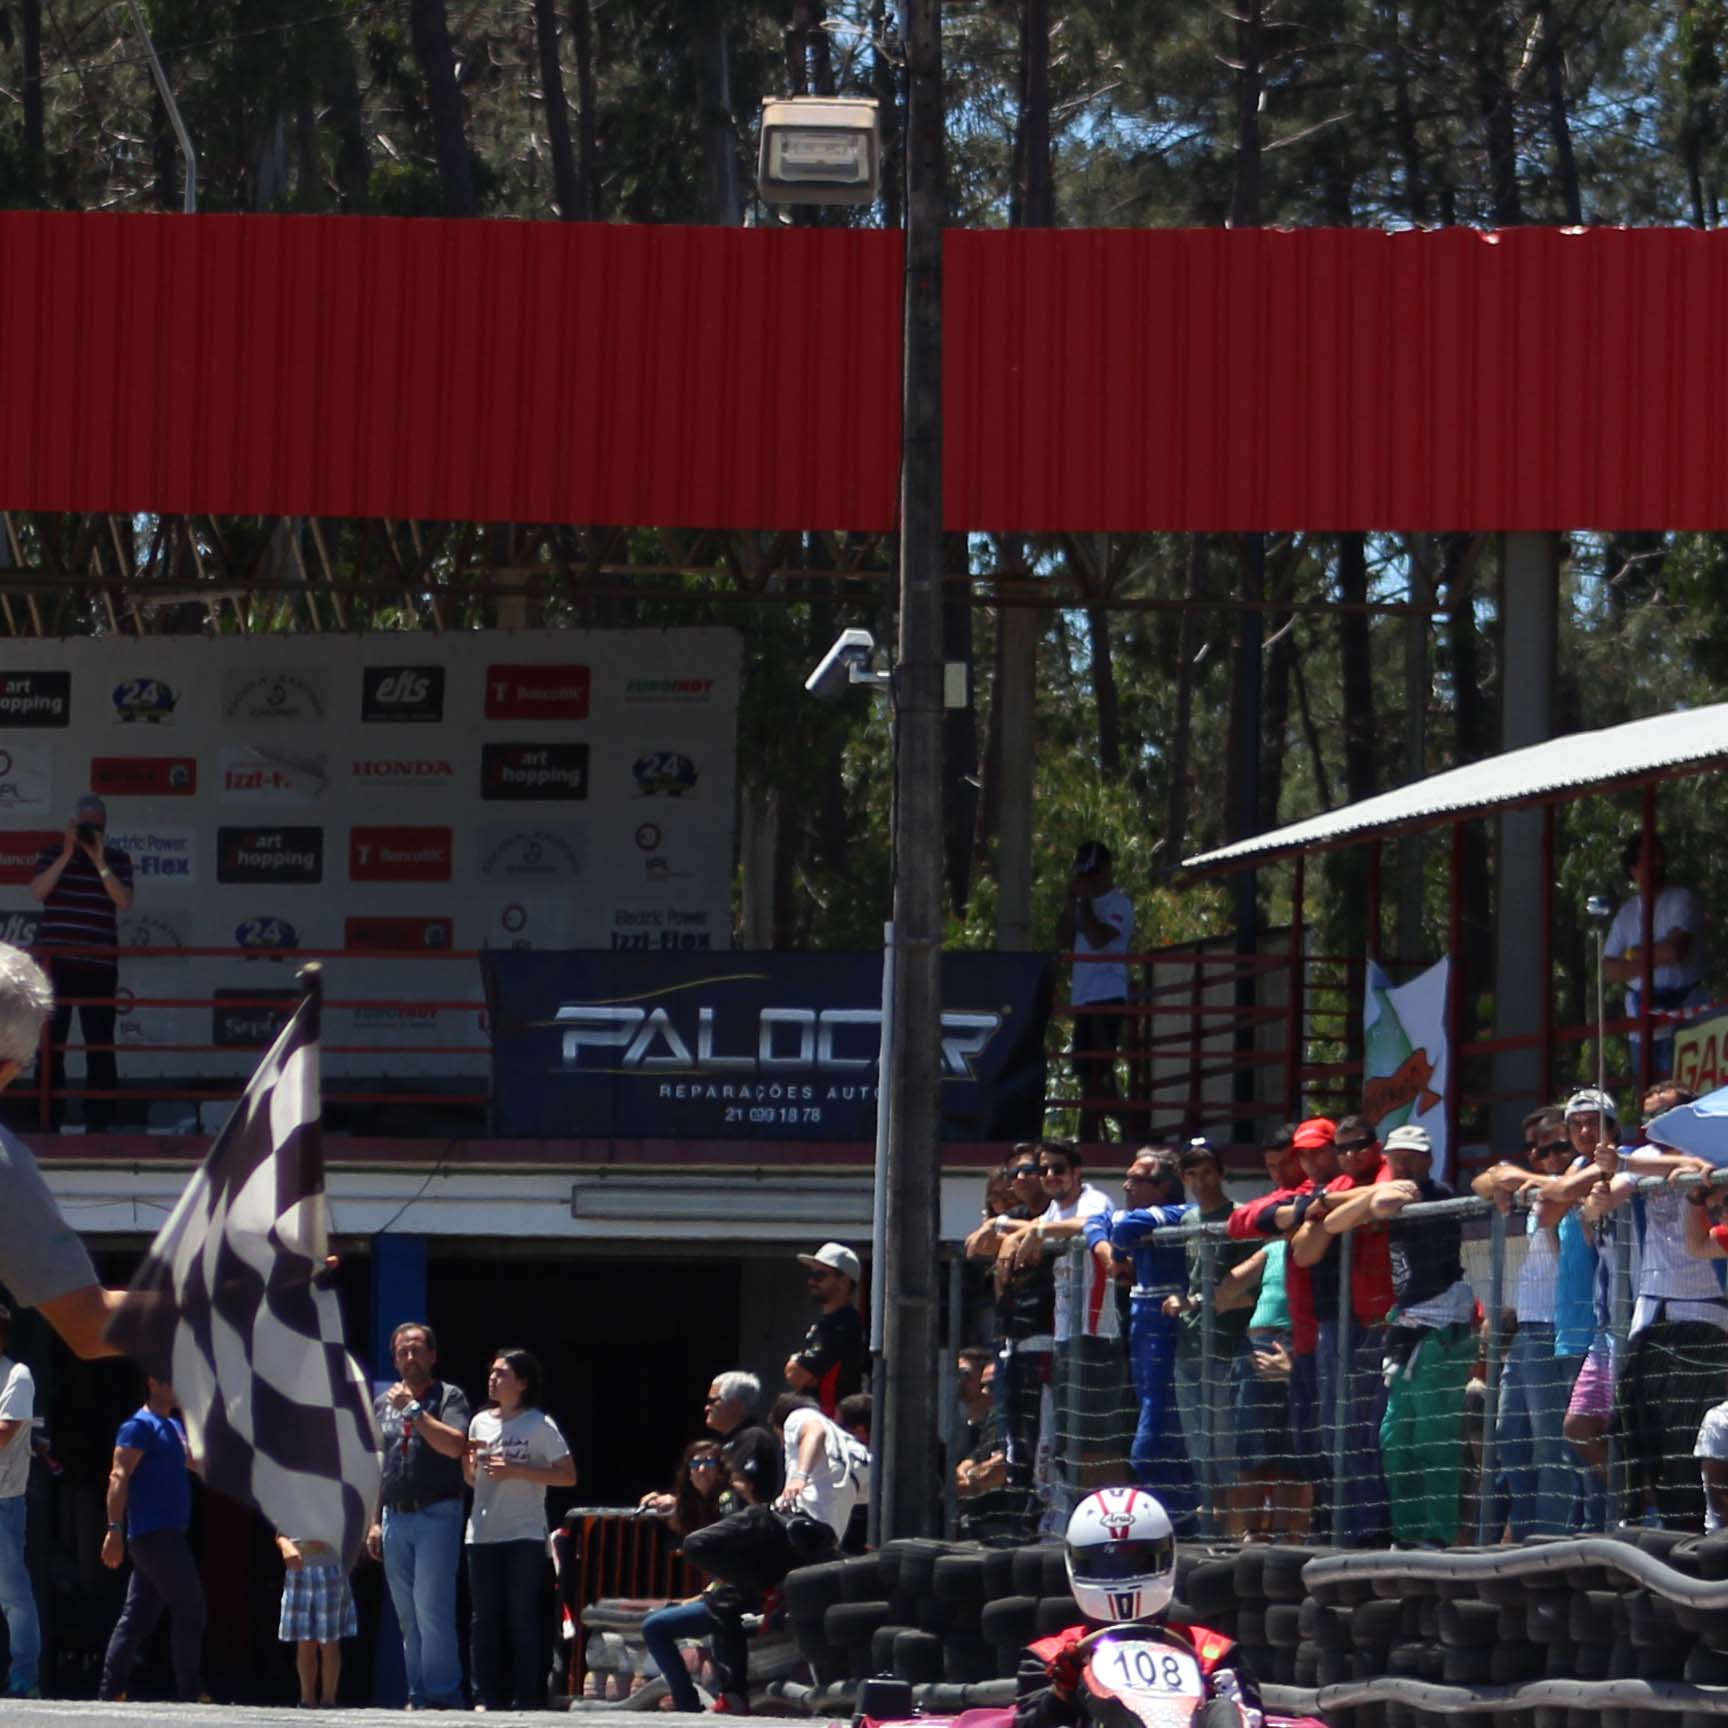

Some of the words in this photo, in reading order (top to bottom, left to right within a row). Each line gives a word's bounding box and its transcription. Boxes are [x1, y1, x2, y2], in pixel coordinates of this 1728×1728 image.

[123, 681, 159, 706] 24
[352, 760, 454, 777] HONDA
[642, 752, 681, 778] 24
[148, 834, 188, 848] Power
[615, 909, 662, 926] Electric
[667, 908, 707, 925] Power
[244, 920, 281, 945] 24
[554, 1006, 1001, 1077] PALOCR
[658, 1083, 813, 1102] REPARAÇÕES
[725, 1107, 742, 1123] 21
[803, 1107, 822, 1123] 78
[1113, 1649, 1183, 1689] 108
